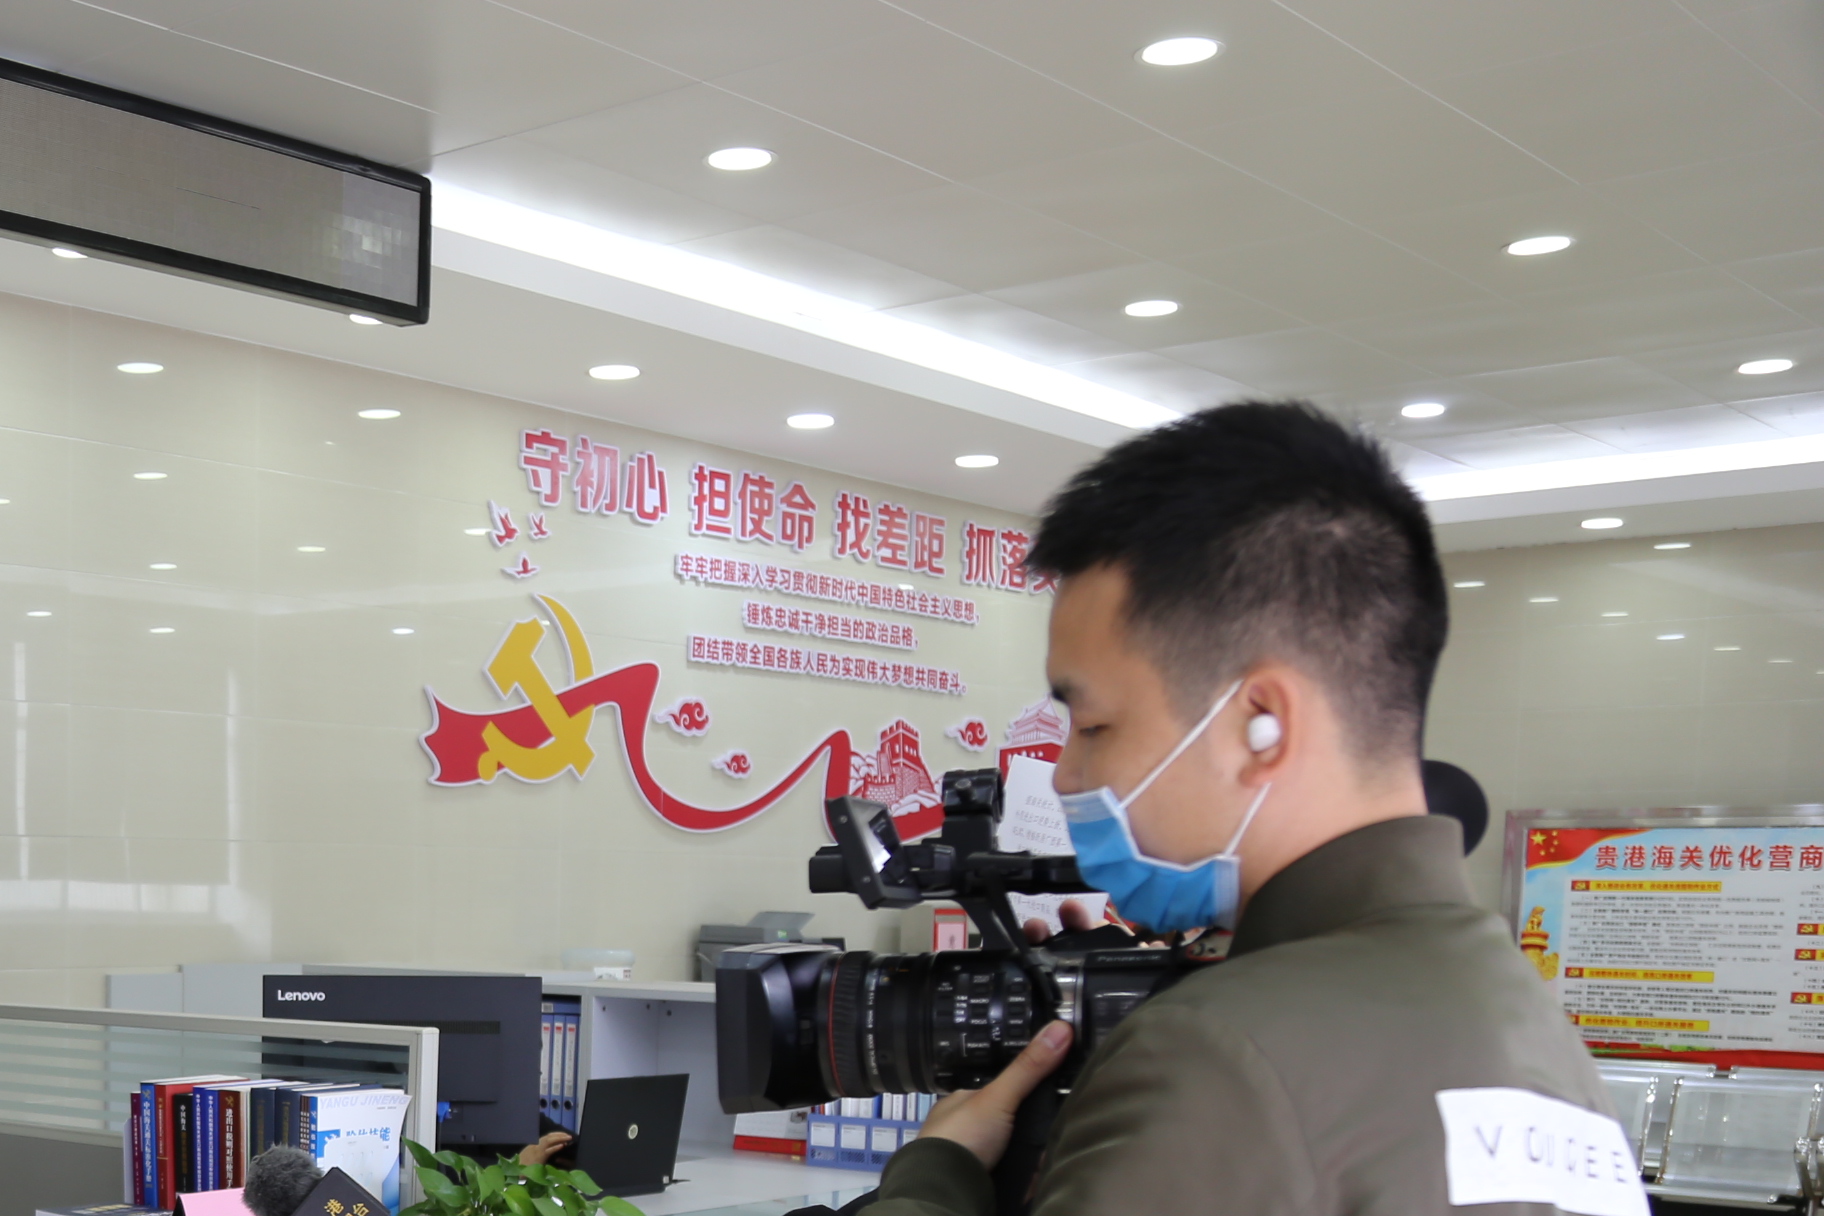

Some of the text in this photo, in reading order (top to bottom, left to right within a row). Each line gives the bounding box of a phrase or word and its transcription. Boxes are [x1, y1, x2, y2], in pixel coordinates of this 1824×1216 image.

[521, 428, 668, 522] 守初心
[691, 463, 817, 551] 担使命
[836, 491, 946, 577] 找差距
[1596, 845, 1824, 869] 贵港海关优化营商
[277, 989, 325, 1001] Lenovo
[319, 1096, 359, 1109] YANGU
